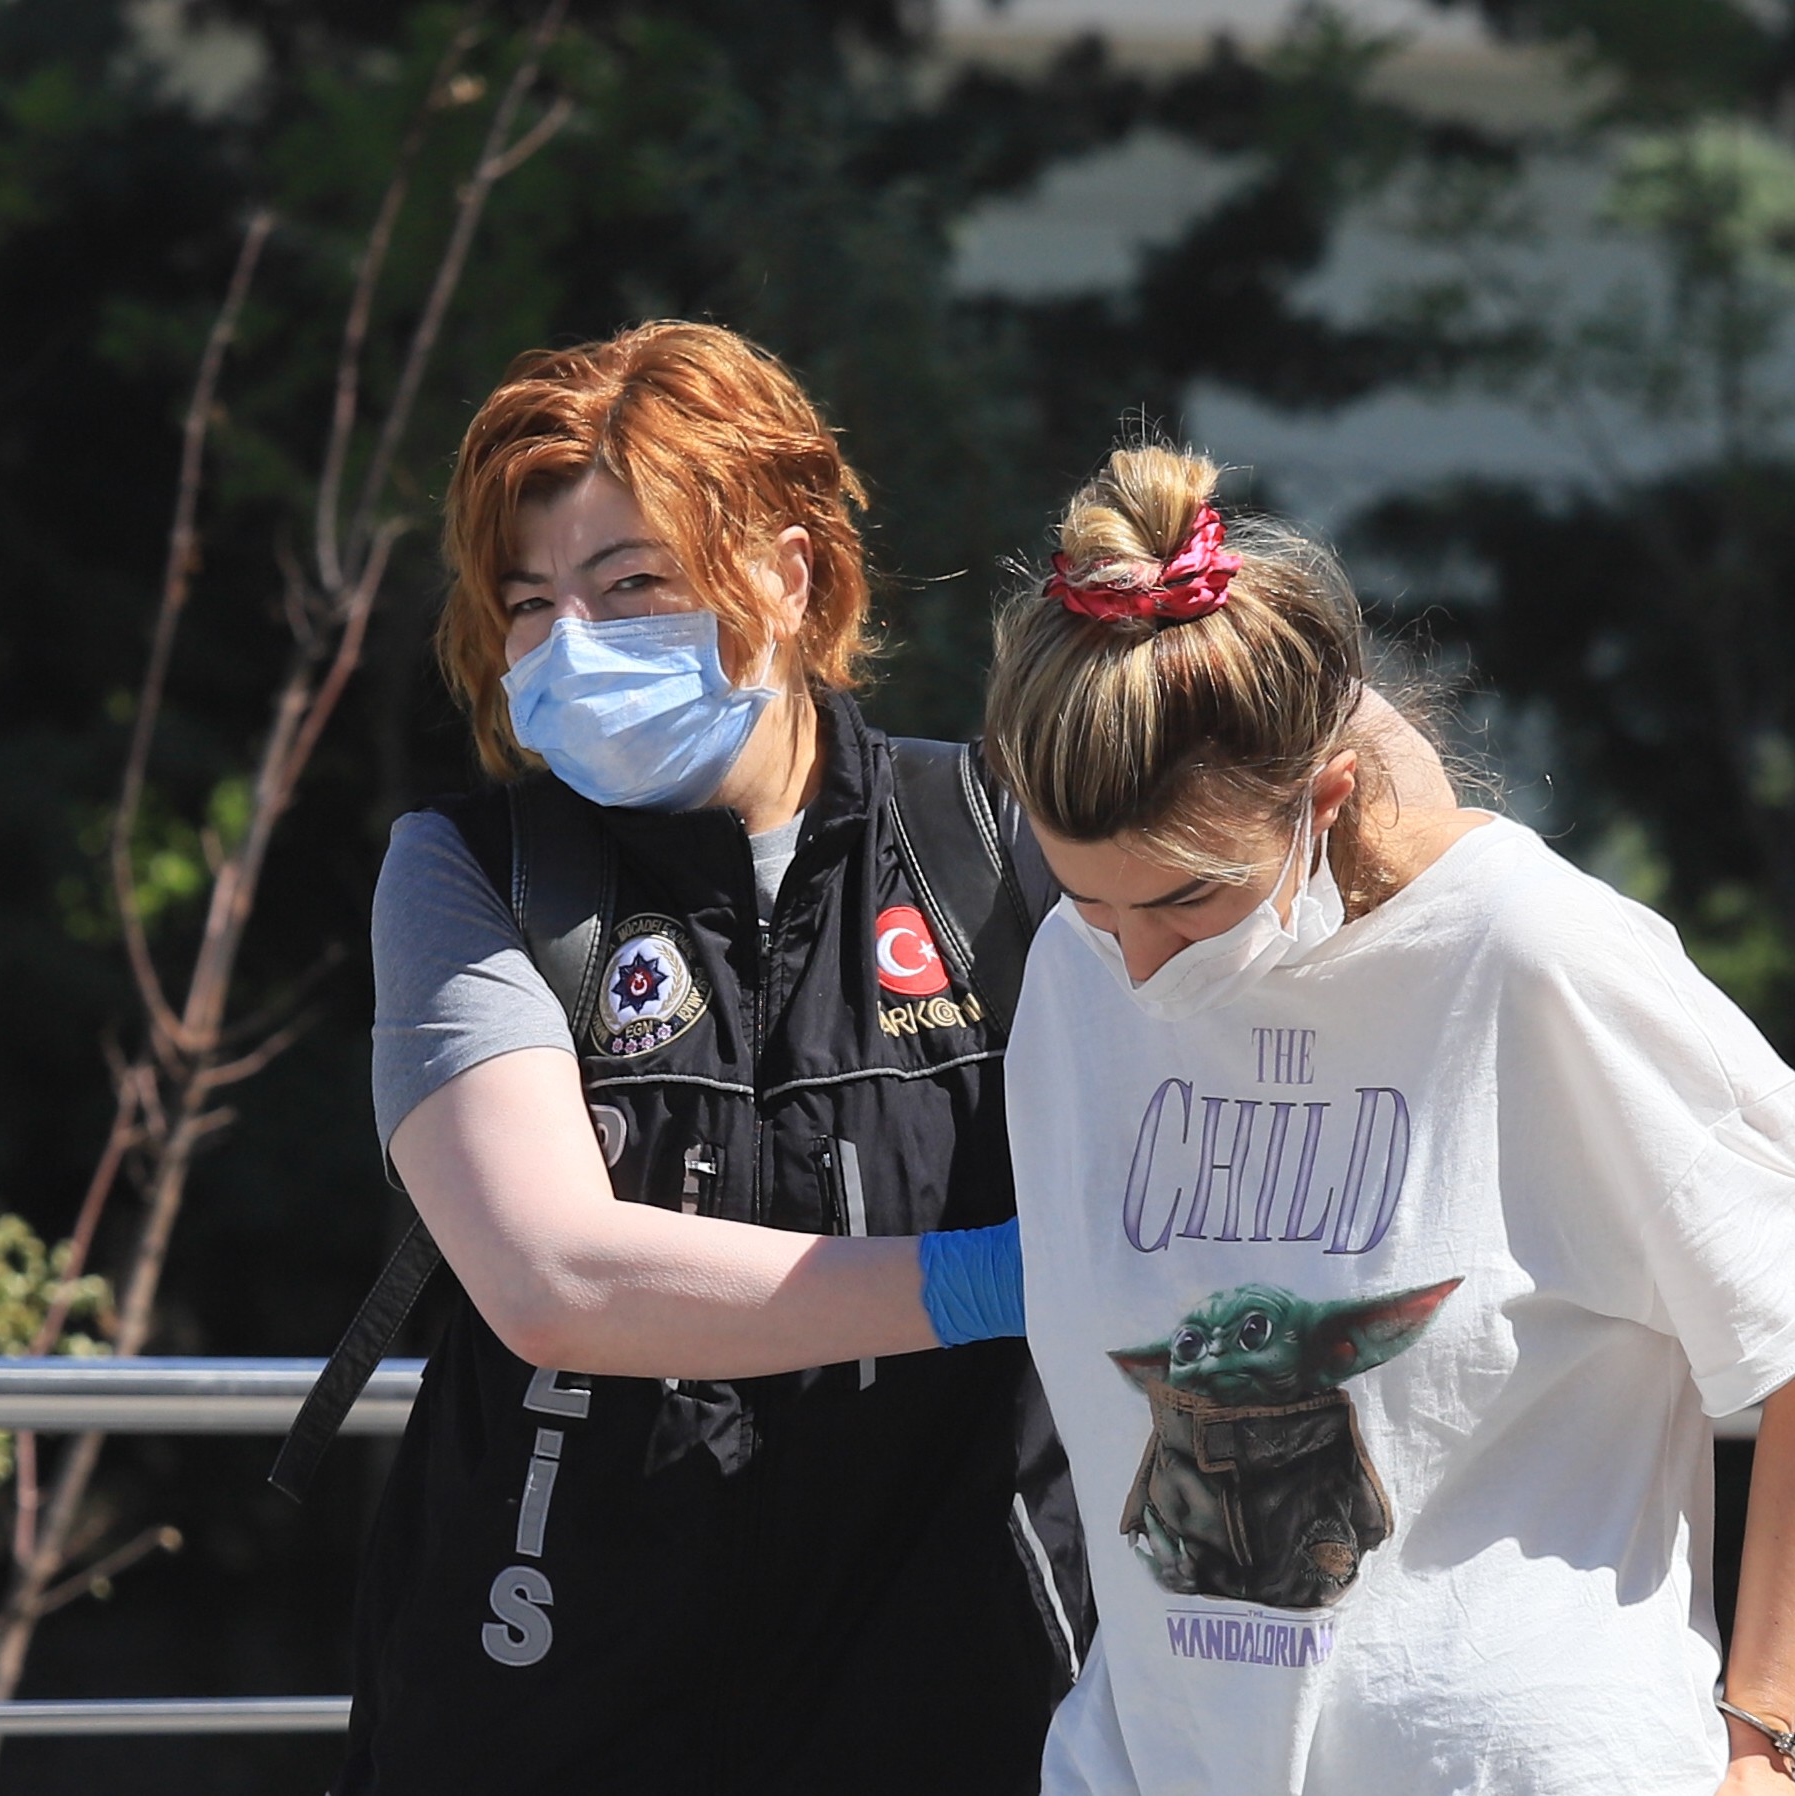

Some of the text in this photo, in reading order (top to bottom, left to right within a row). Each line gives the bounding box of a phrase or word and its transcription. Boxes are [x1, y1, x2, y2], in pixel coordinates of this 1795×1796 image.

[625, 1020, 654, 1038] EGM
[1251, 1027, 1316, 1085] THE
[1122, 1077, 1411, 1256] CHILD
[1166, 1616, 1335, 1668] MANDALORIAN
